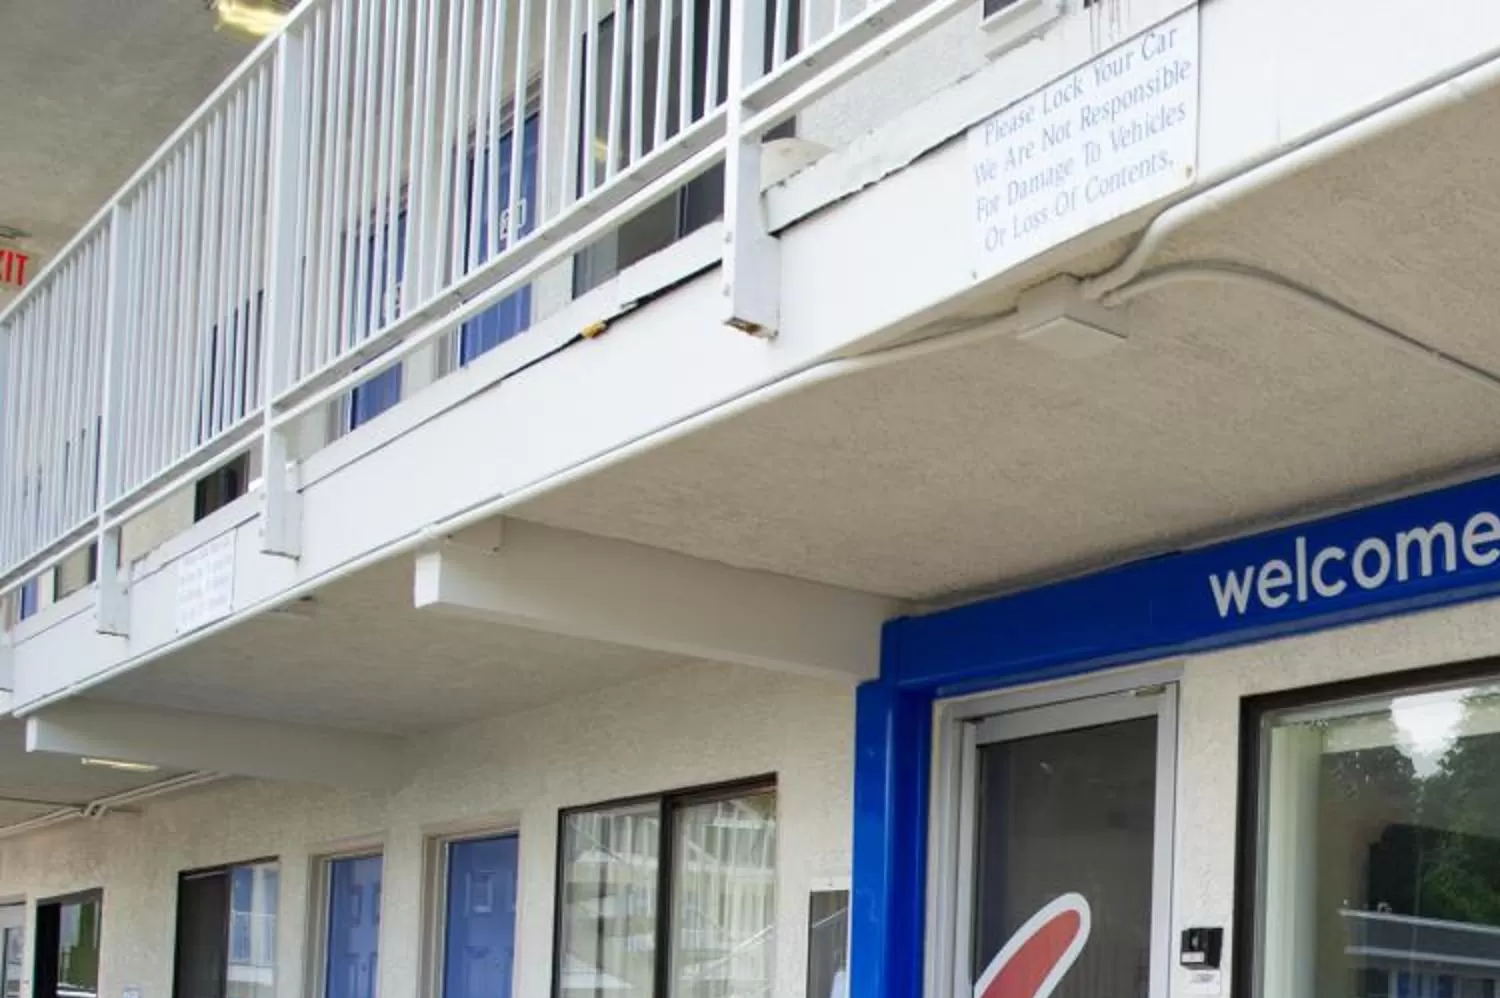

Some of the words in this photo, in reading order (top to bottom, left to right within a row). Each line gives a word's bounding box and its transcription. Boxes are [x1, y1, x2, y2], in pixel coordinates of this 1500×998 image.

[973, 159, 997, 188] We
[1004, 140, 1035, 172] Are
[1041, 119, 1072, 152] Not
[1080, 60, 1192, 131] Responsible
[984, 104, 1035, 146] Please
[1042, 75, 1083, 116] Lock
[1093, 51, 1134, 87] Your
[1141, 28, 1178, 61] Car
[976, 195, 1000, 223] For
[1006, 156, 1074, 206] Damage
[1082, 141, 1101, 168] To
[1108, 102, 1186, 153] Vehicles
[984, 225, 1006, 252] Or
[1013, 207, 1049, 240] Loss
[1055, 185, 1081, 216] Of
